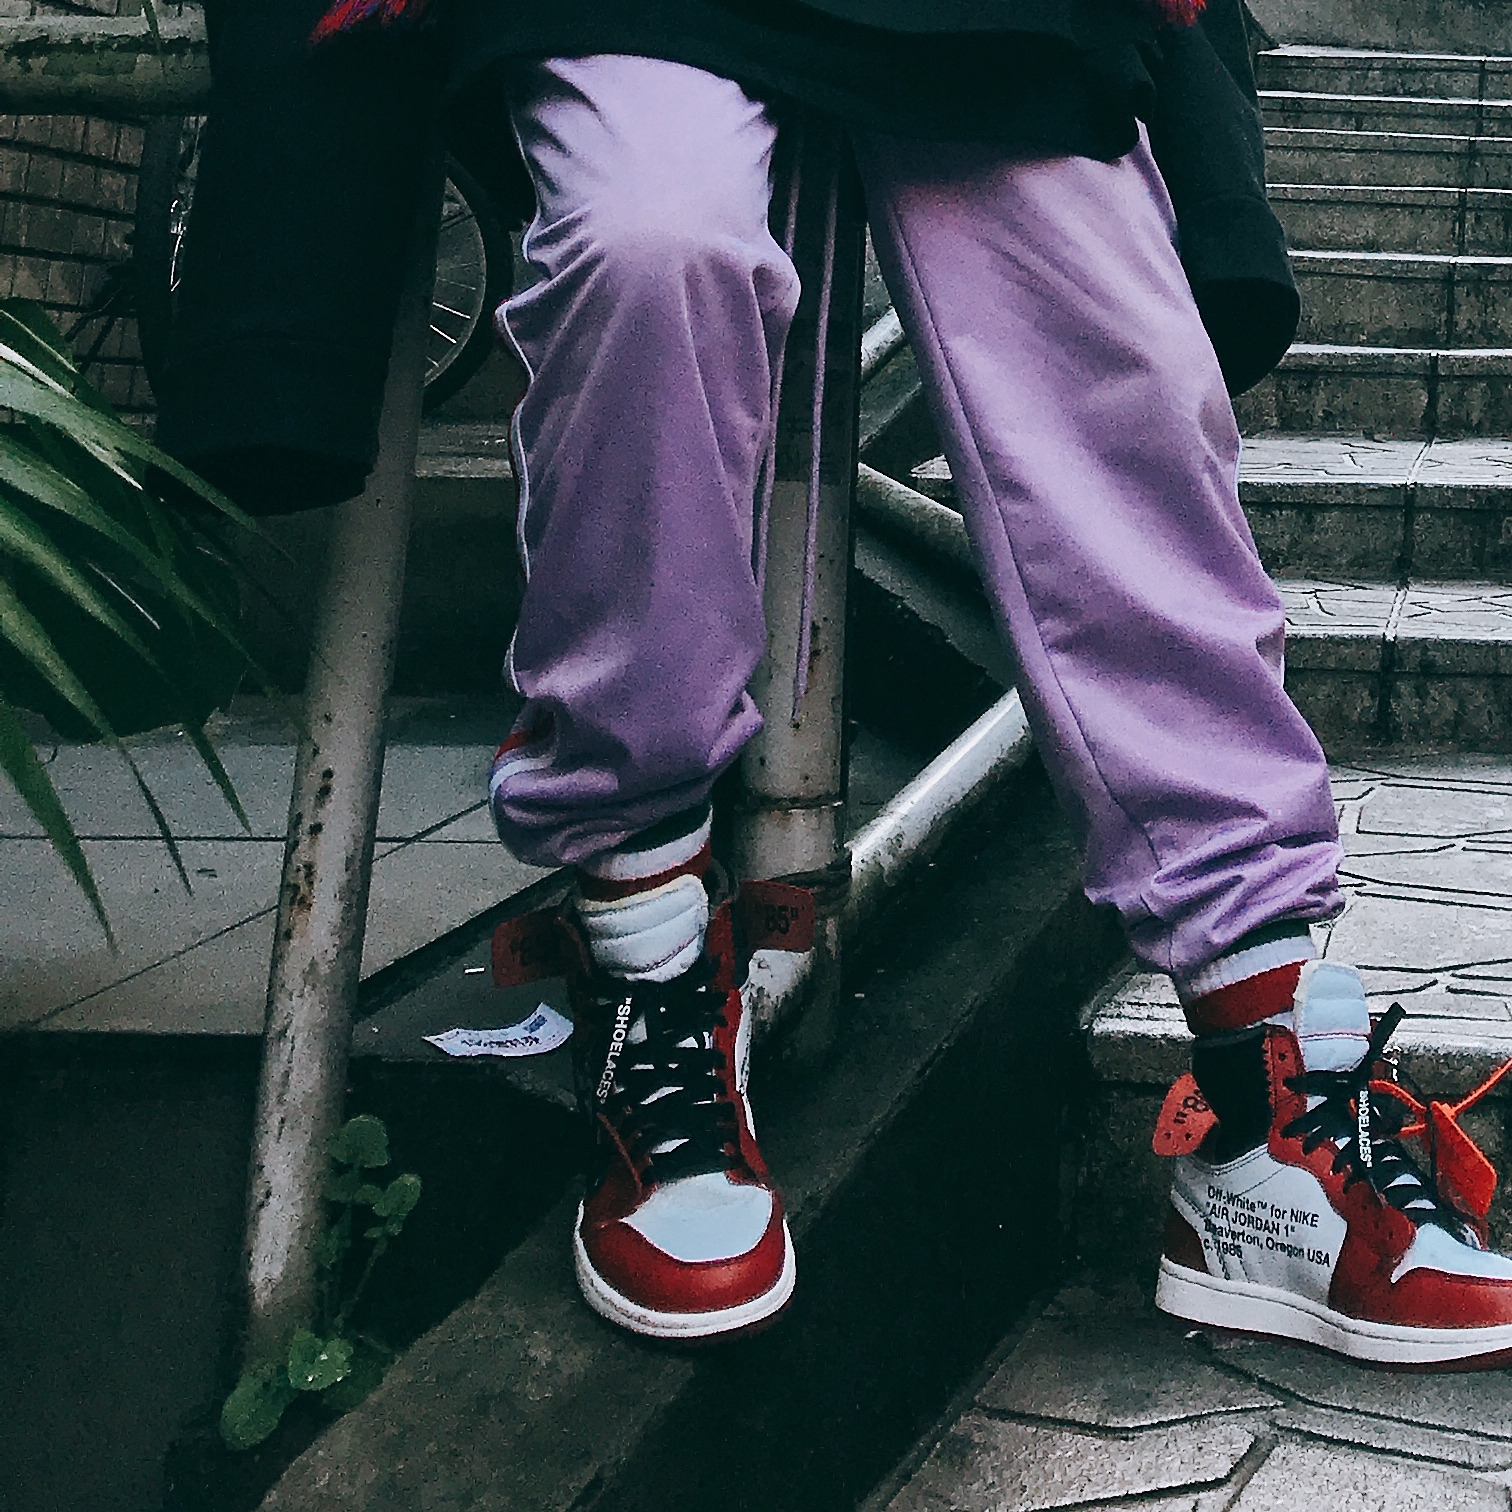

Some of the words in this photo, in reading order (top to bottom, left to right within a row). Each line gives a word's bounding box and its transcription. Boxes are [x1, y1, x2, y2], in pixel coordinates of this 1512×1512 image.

[1232, 1210, 1281, 1236] JORDAN
[1270, 1203, 1287, 1220] for
[1290, 1208, 1320, 1228] NIKE
[1265, 1236, 1305, 1258] Oregon
[1307, 1248, 1331, 1268] USA
